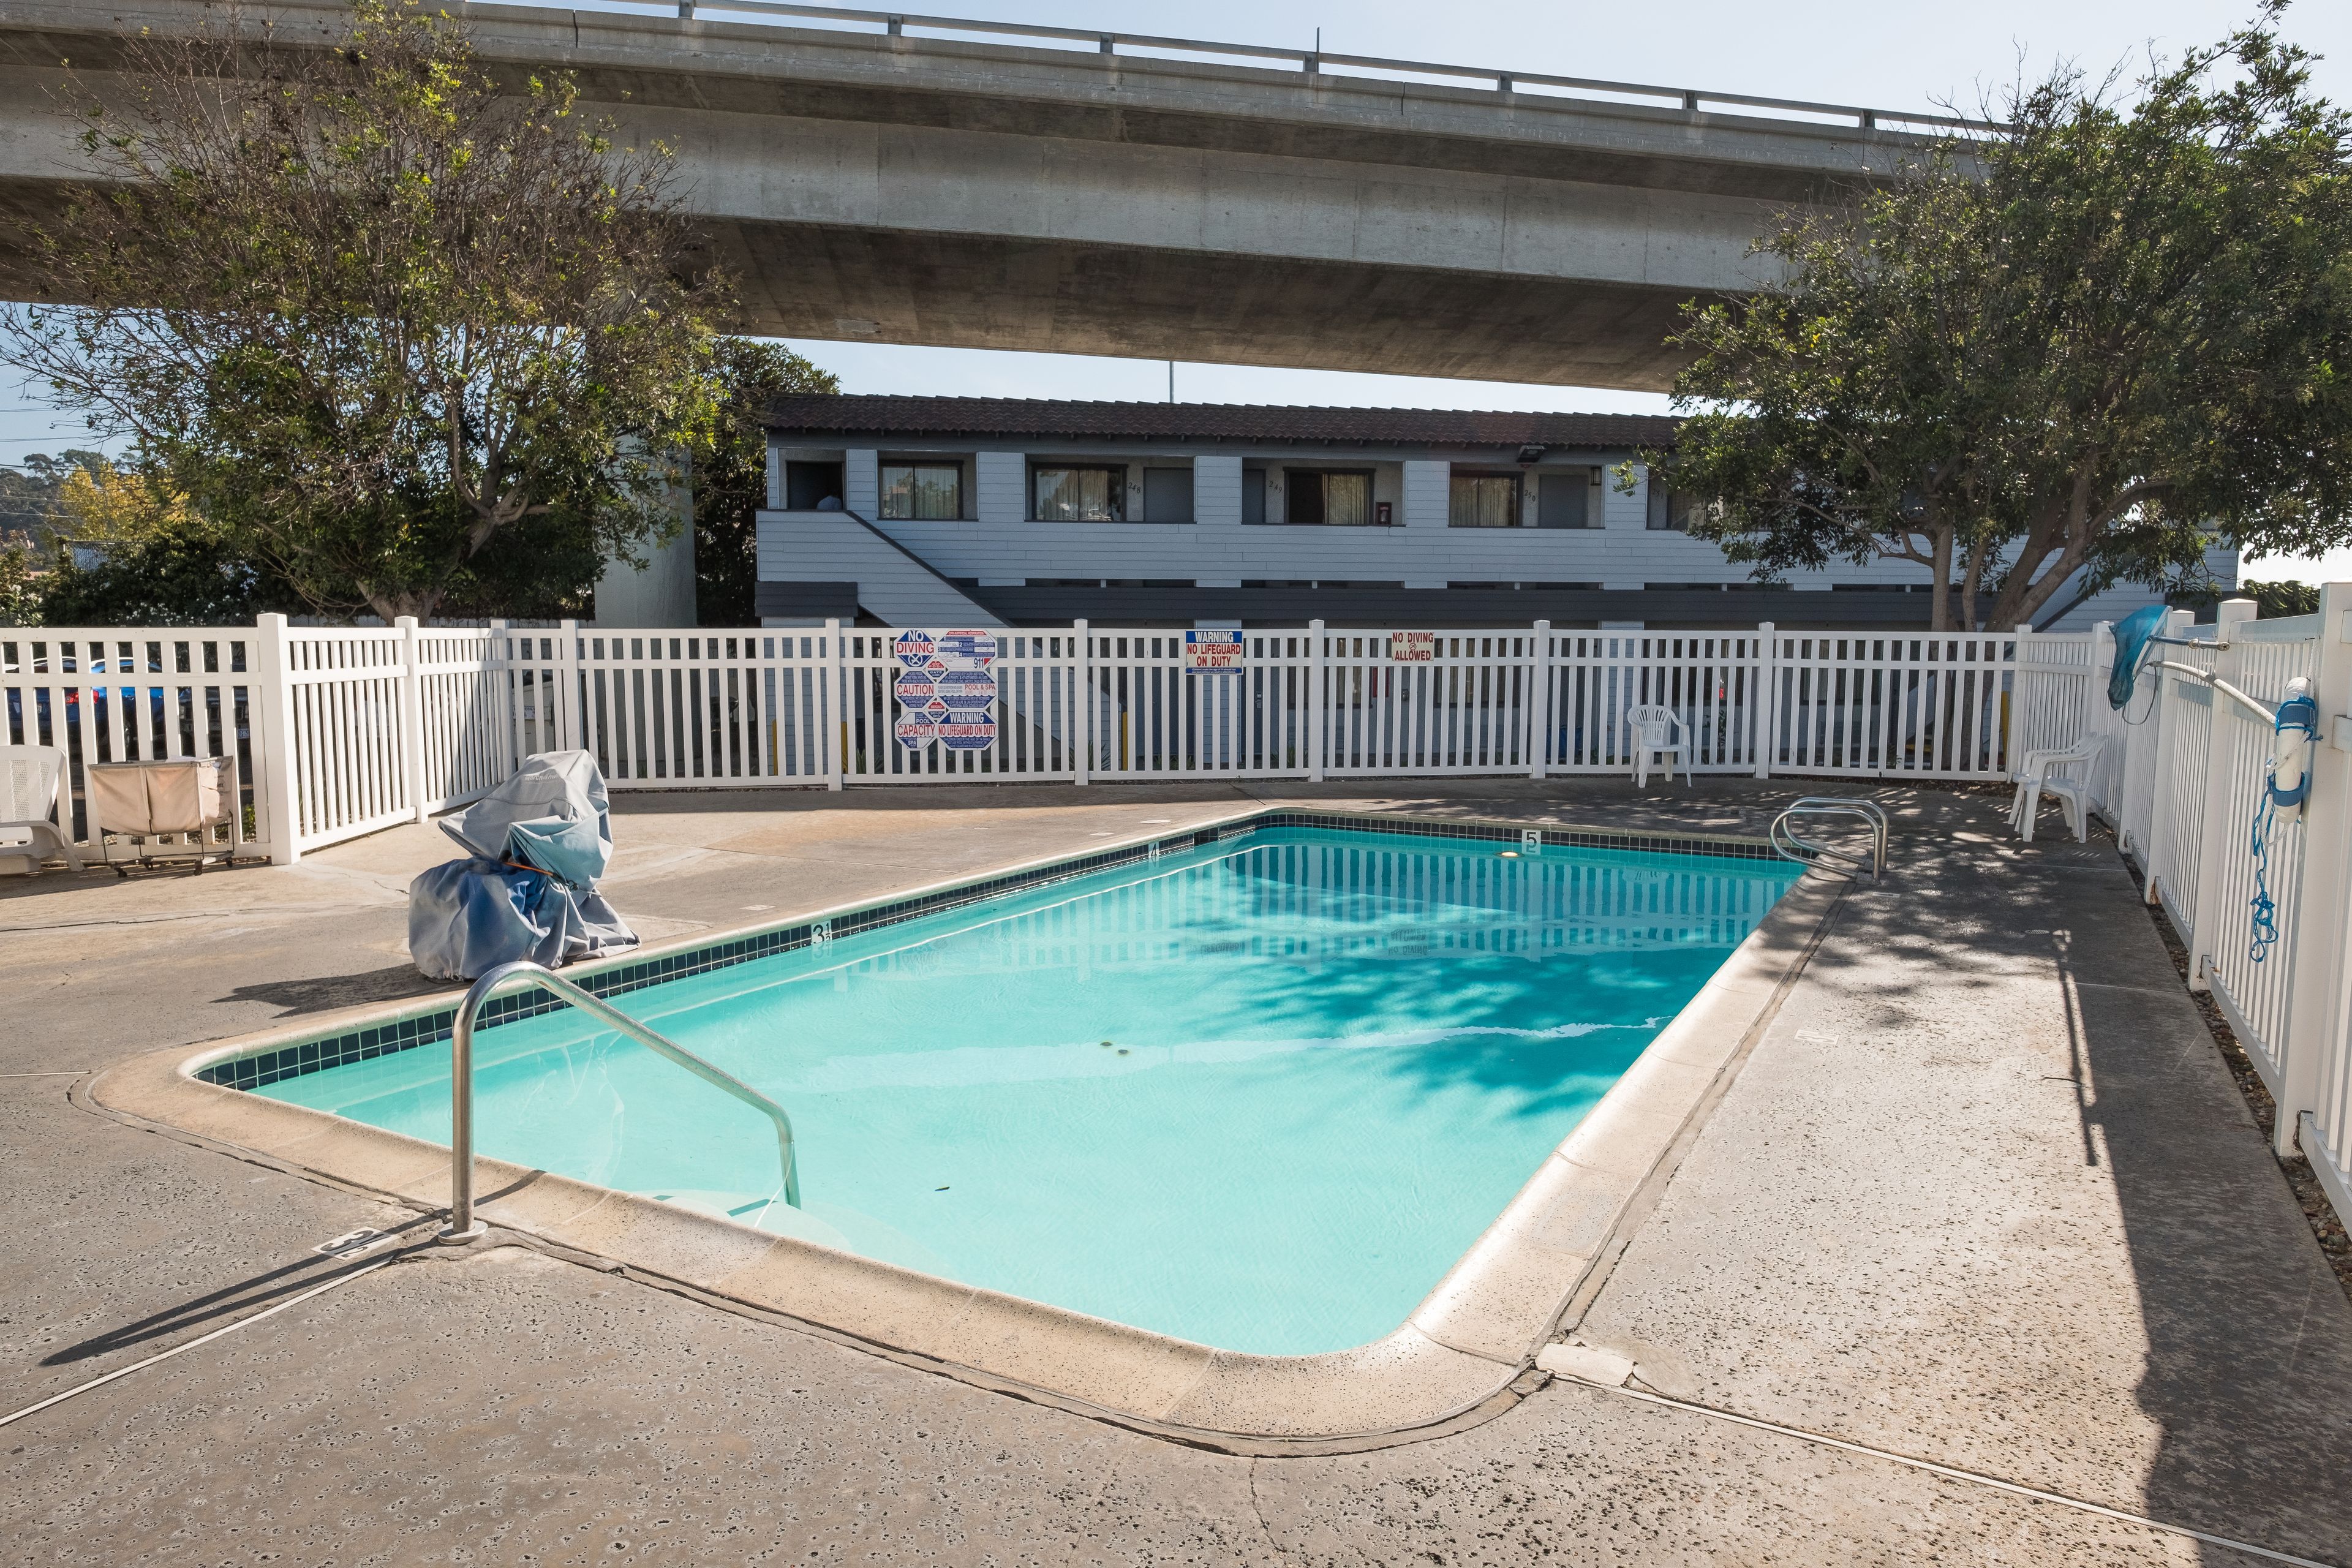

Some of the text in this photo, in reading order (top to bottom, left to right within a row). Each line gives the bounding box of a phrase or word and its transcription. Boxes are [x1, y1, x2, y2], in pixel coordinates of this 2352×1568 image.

[908, 630, 924, 642] NO
[1195, 631, 1234, 643] WARNING
[1393, 632, 1433, 643] NO DIVING
[897, 643, 935, 654] DIVING
[1187, 644, 1241, 655] NO LIFEGUARD
[1197, 656, 1231, 666] ON DUTY
[1395, 650, 1431, 661] ALLOWED
[974, 658, 984, 669] 911
[897, 684, 934, 695] CAUTION
[950, 712, 984, 723] WARNING
[898, 725, 935, 736] CAPACITY
[938, 725, 996, 736] NO LIFEGUARD ON DUTY
